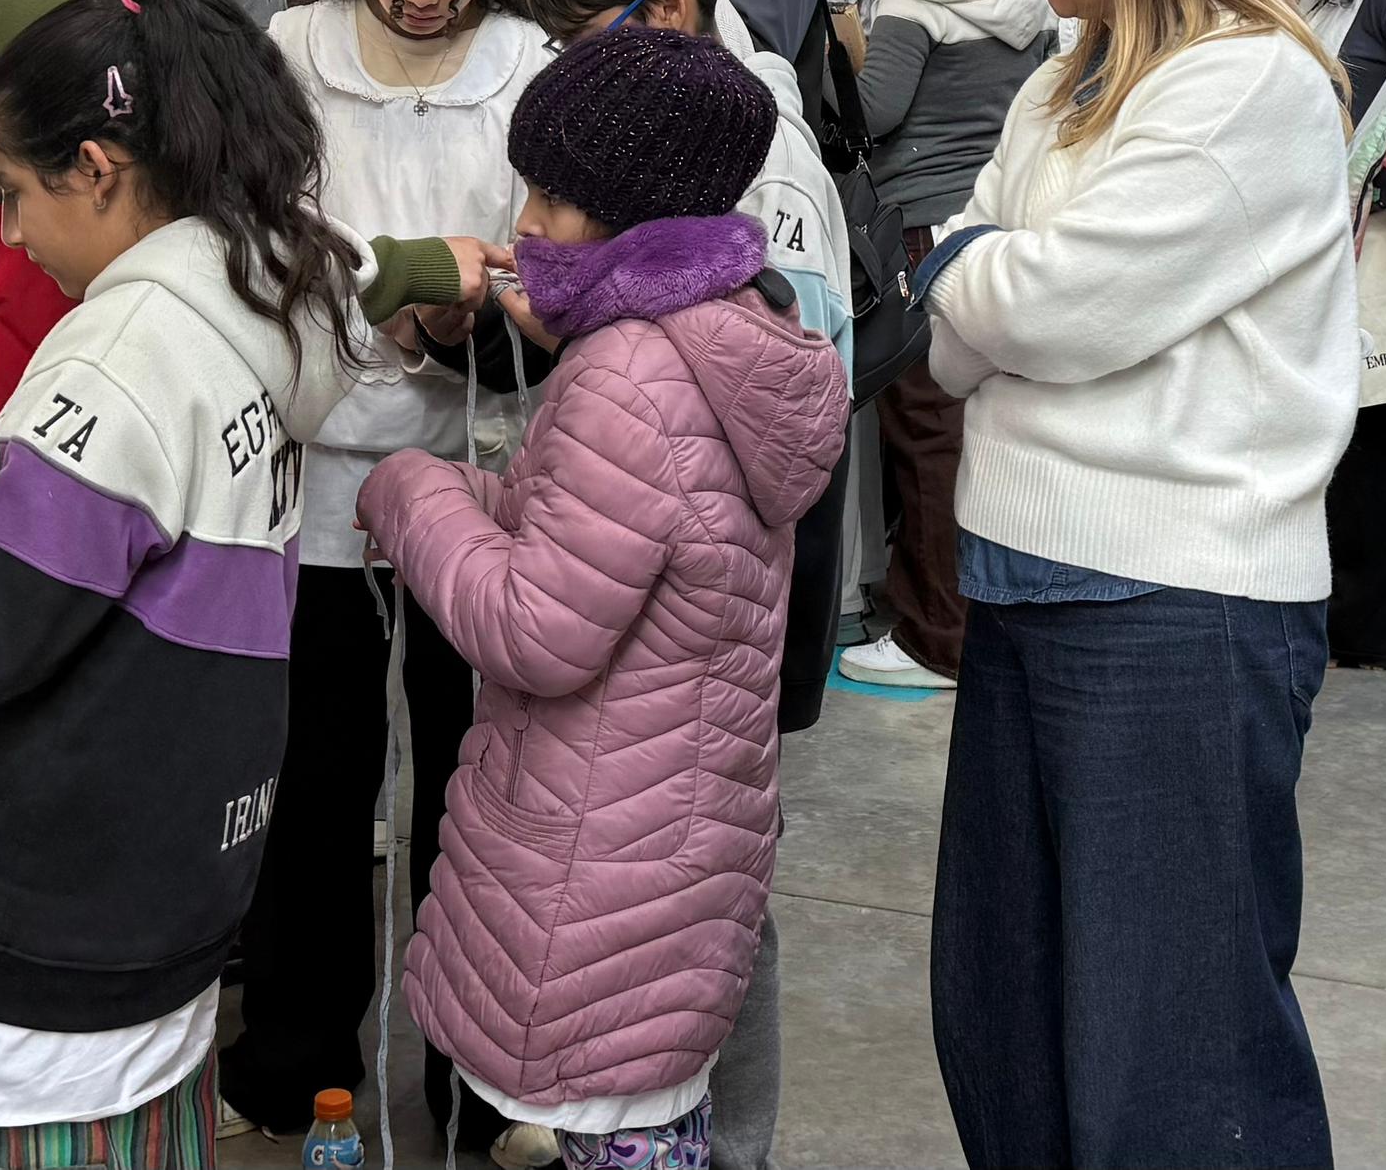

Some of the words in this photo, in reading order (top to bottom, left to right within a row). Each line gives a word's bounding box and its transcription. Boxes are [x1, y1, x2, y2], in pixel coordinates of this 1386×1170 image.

[786, 217, 806, 253] A
[57, 415, 99, 463] A
[220, 777, 277, 852] IRIN
